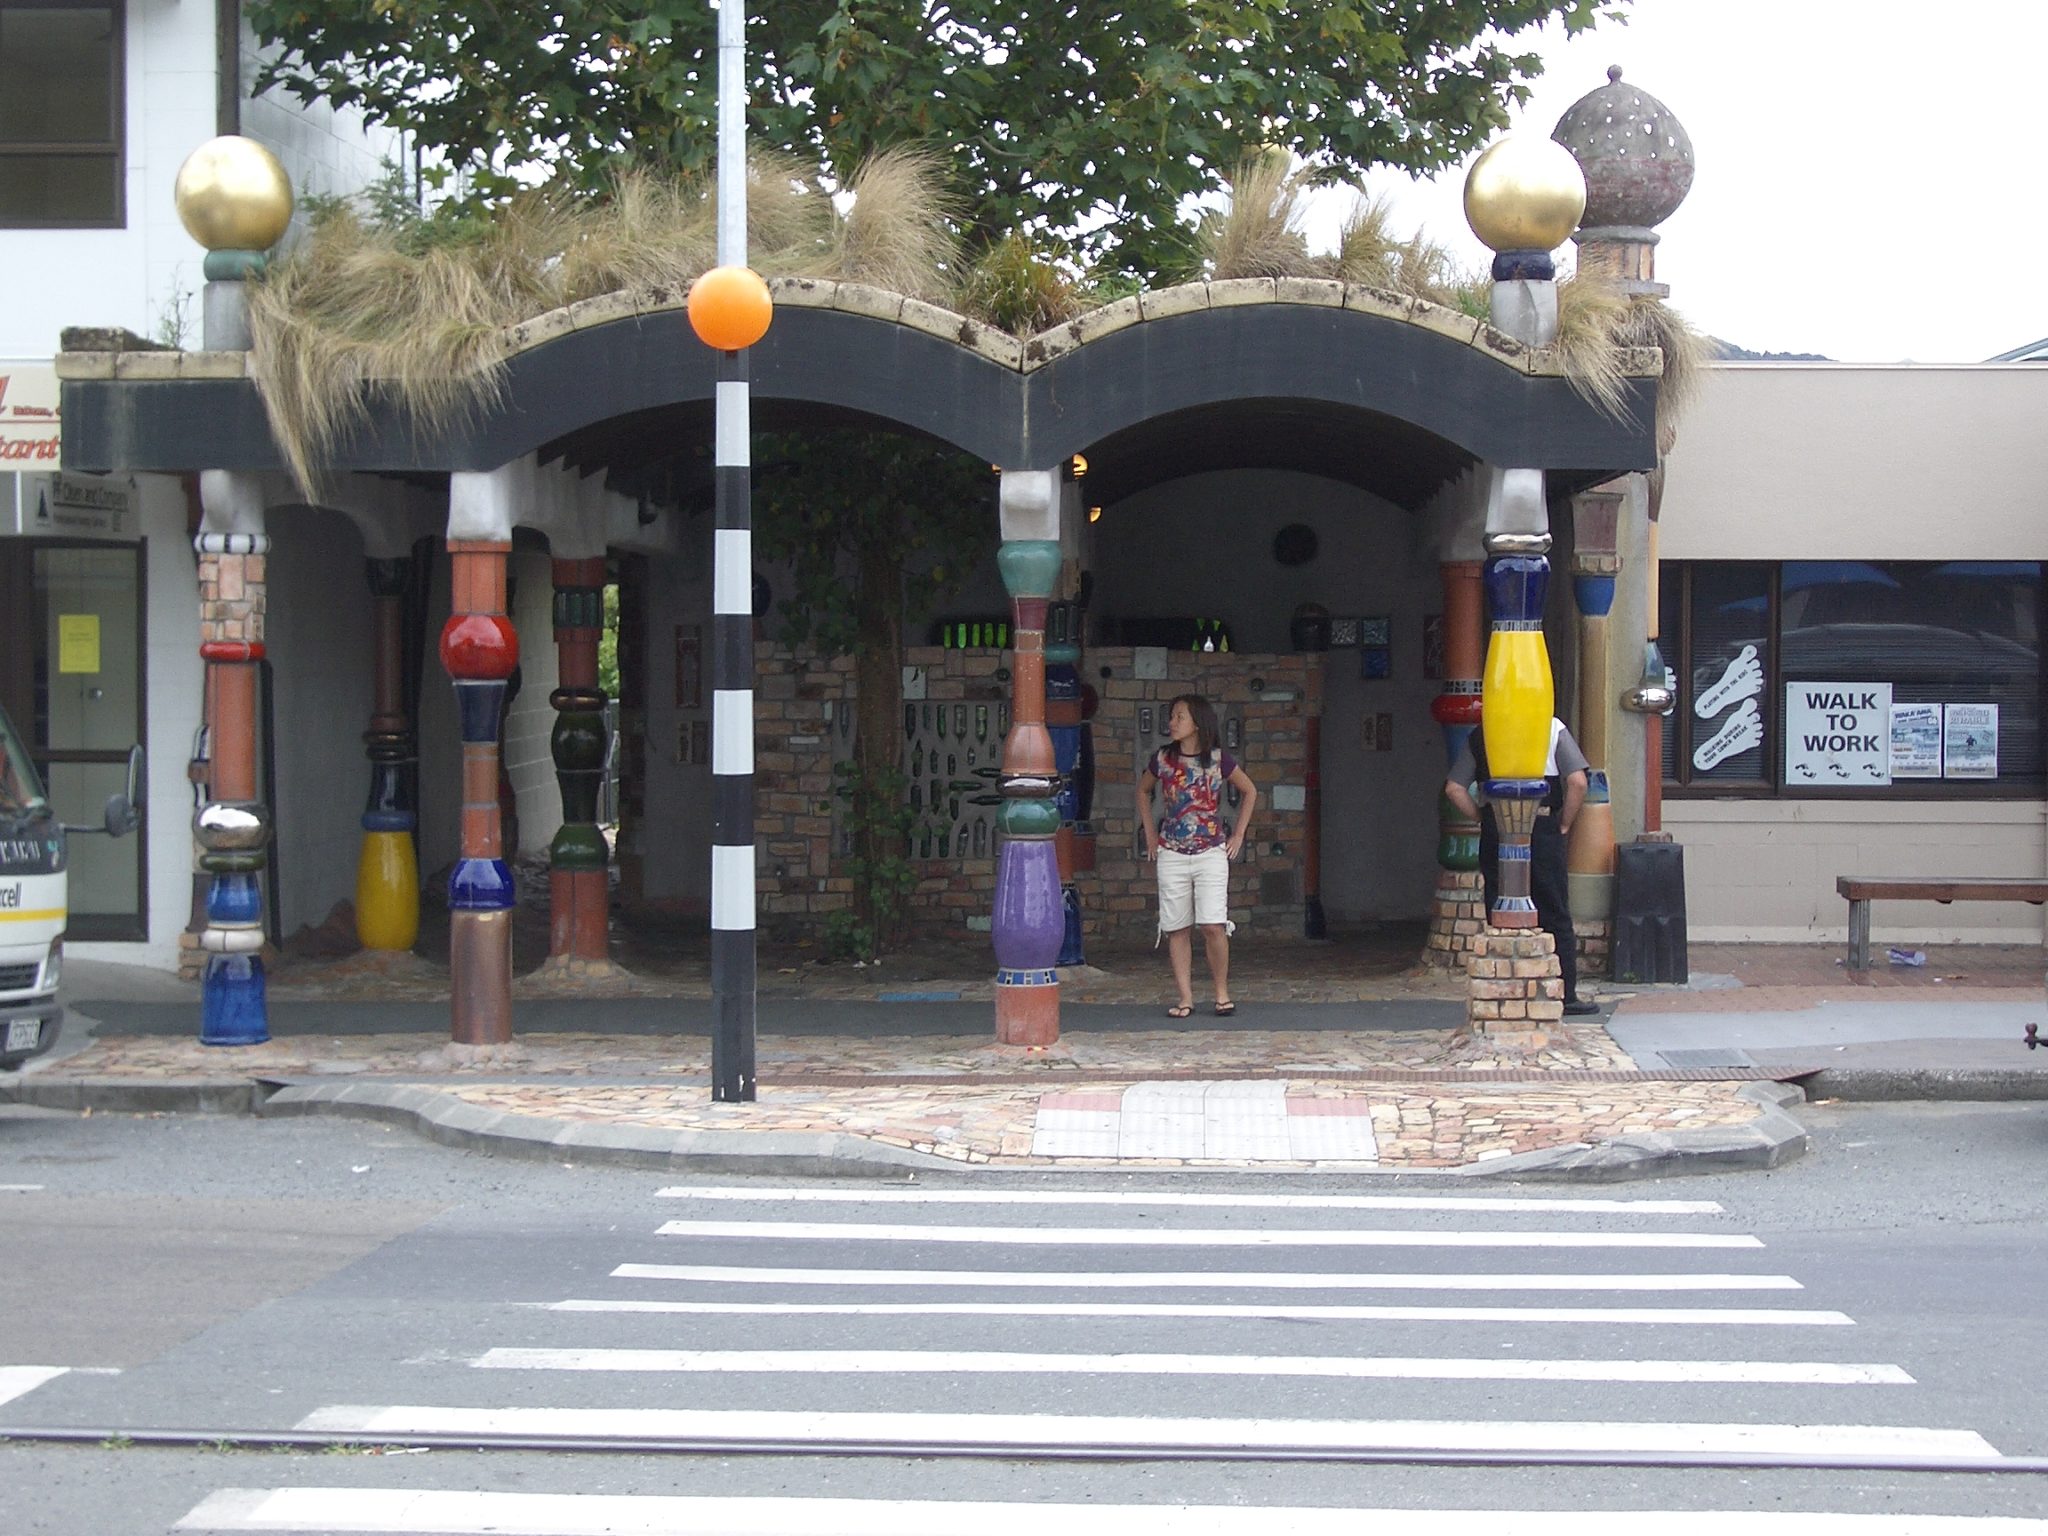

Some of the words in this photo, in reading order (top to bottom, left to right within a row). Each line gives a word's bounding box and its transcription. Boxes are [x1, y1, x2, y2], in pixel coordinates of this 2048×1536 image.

[1806, 693, 1878, 710] WALK
[1826, 714, 1858, 731] TO
[1803, 735, 1880, 752] WORK
